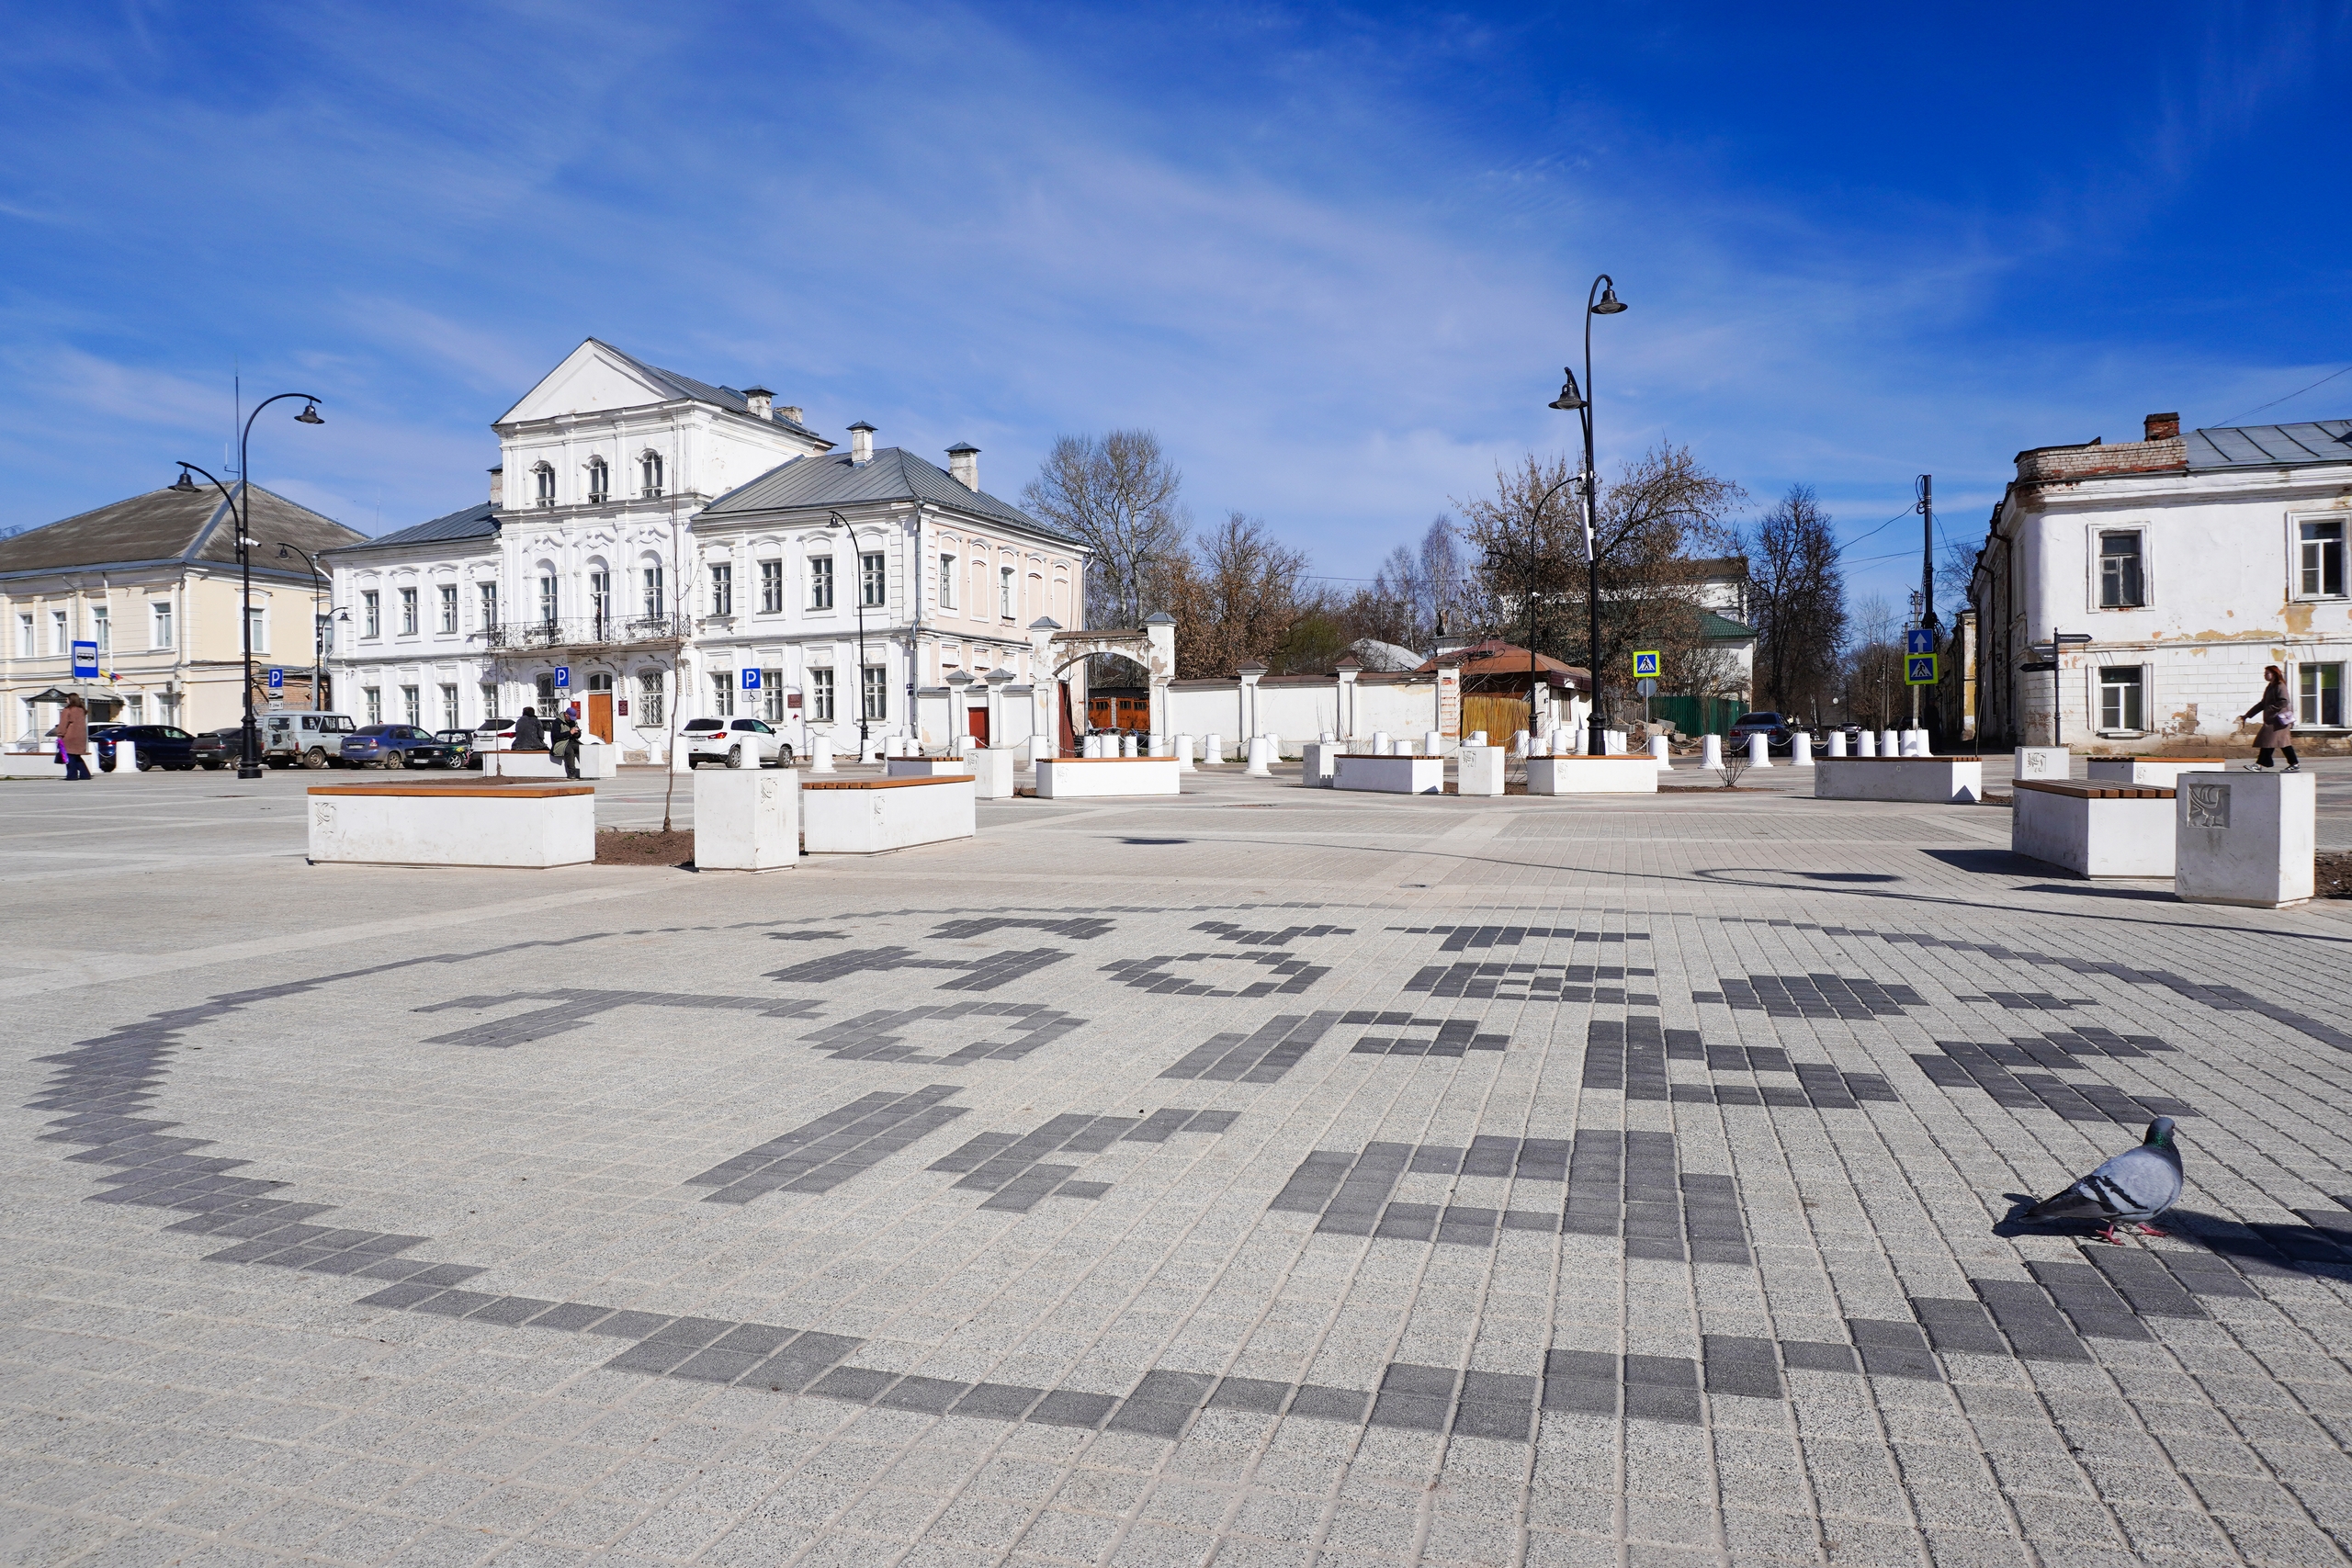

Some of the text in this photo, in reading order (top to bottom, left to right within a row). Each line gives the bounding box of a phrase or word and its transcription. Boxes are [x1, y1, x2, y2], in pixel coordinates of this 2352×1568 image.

[271, 671, 280, 686] P
[558, 669, 567, 685] P
[746, 671, 757, 688] P
